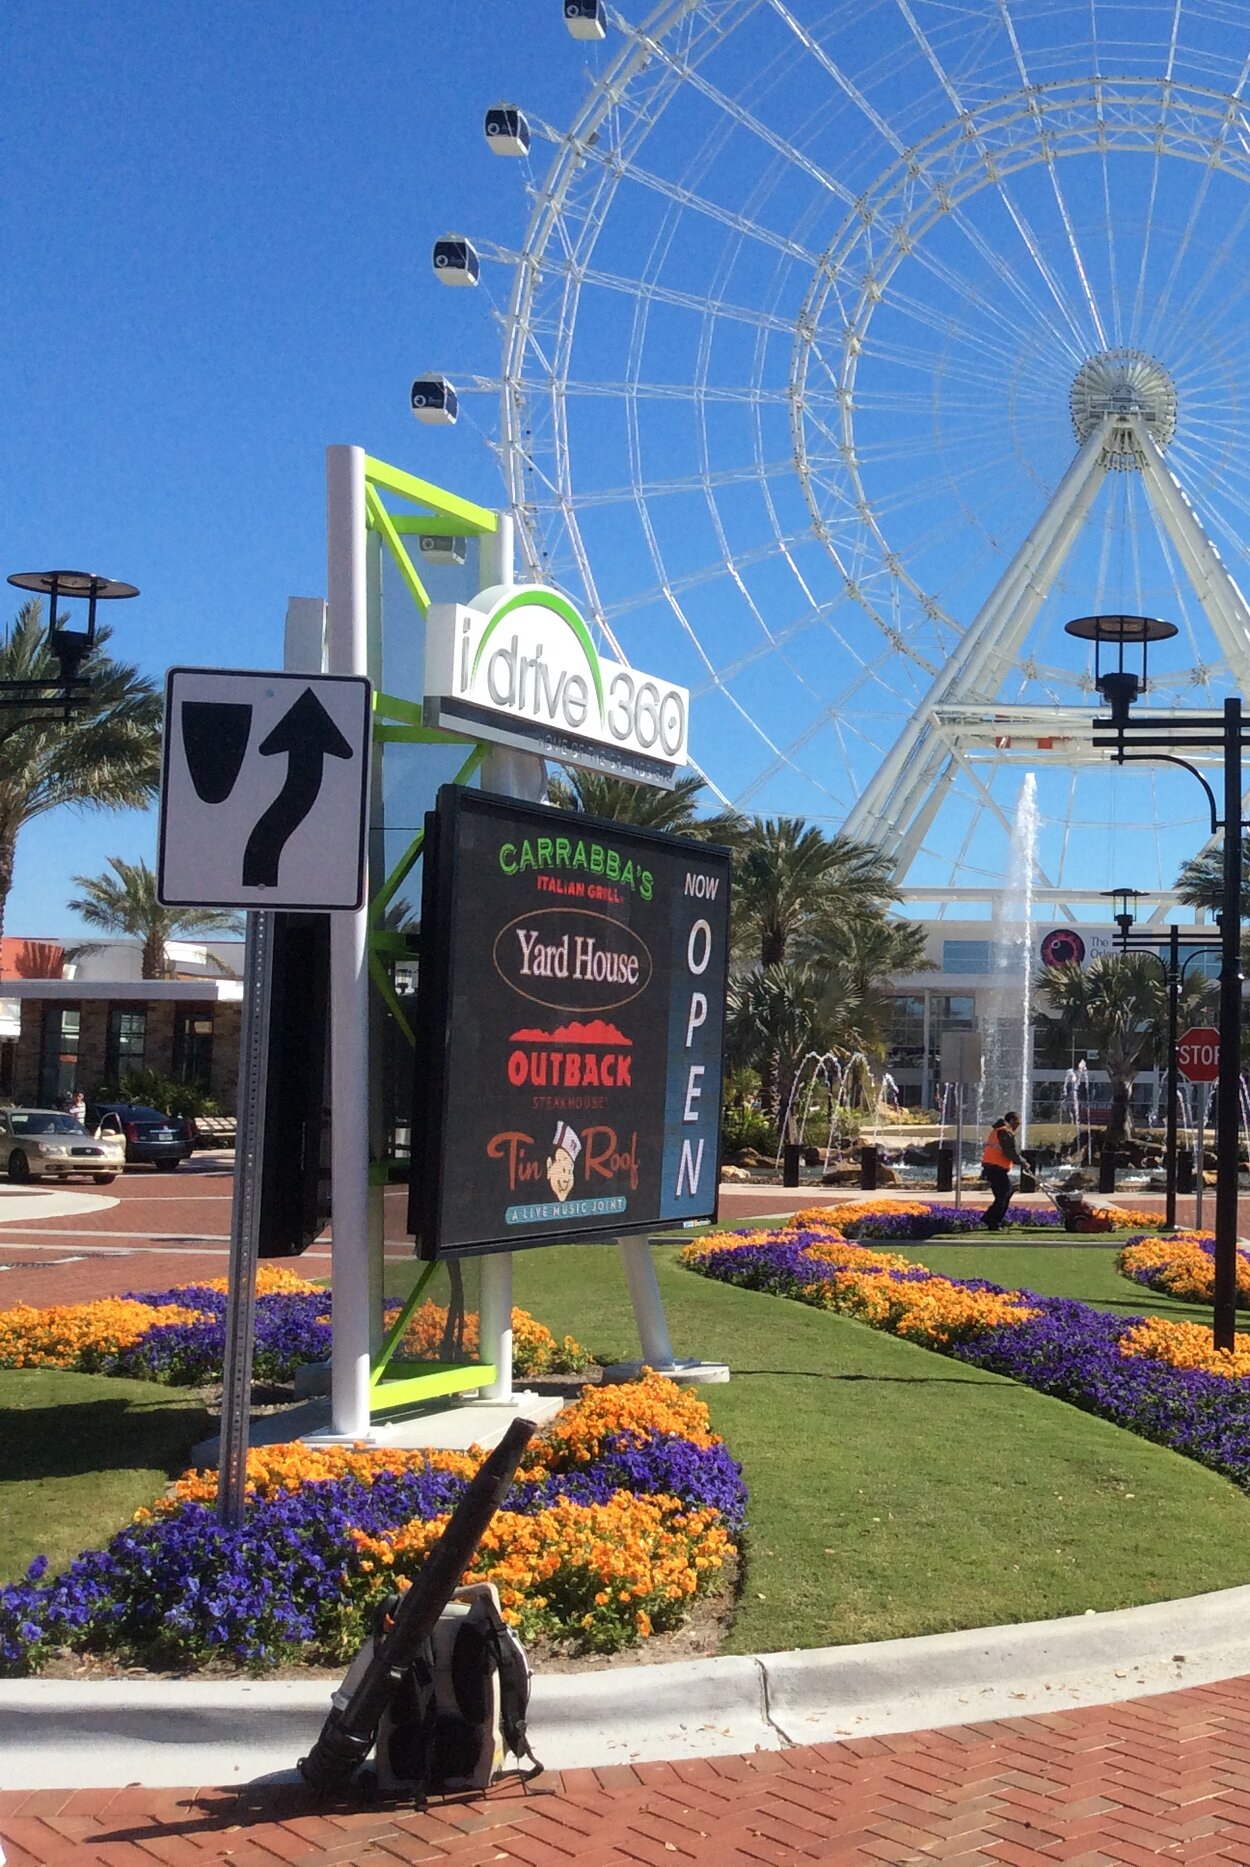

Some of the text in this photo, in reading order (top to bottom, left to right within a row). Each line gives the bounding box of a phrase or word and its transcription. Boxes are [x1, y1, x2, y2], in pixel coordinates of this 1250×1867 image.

[460, 616, 686, 757] i drive 360
[498, 837, 654, 901] CARRABBA'S
[536, 875, 585, 896] ITALIAN
[684, 871, 719, 902] NOW
[516, 928, 640, 985] Yard House
[1090, 936, 1109, 947] The
[1090, 949, 1119, 960] Orlan
[507, 1049, 632, 1088] OUTBACK
[674, 918, 713, 1199] OPEN
[532, 1096, 606, 1111] STEAKHOUSE
[487, 1125, 640, 1191] Tin Roof
[511, 1198, 624, 1222] A LIVE MUSIC JOINT
